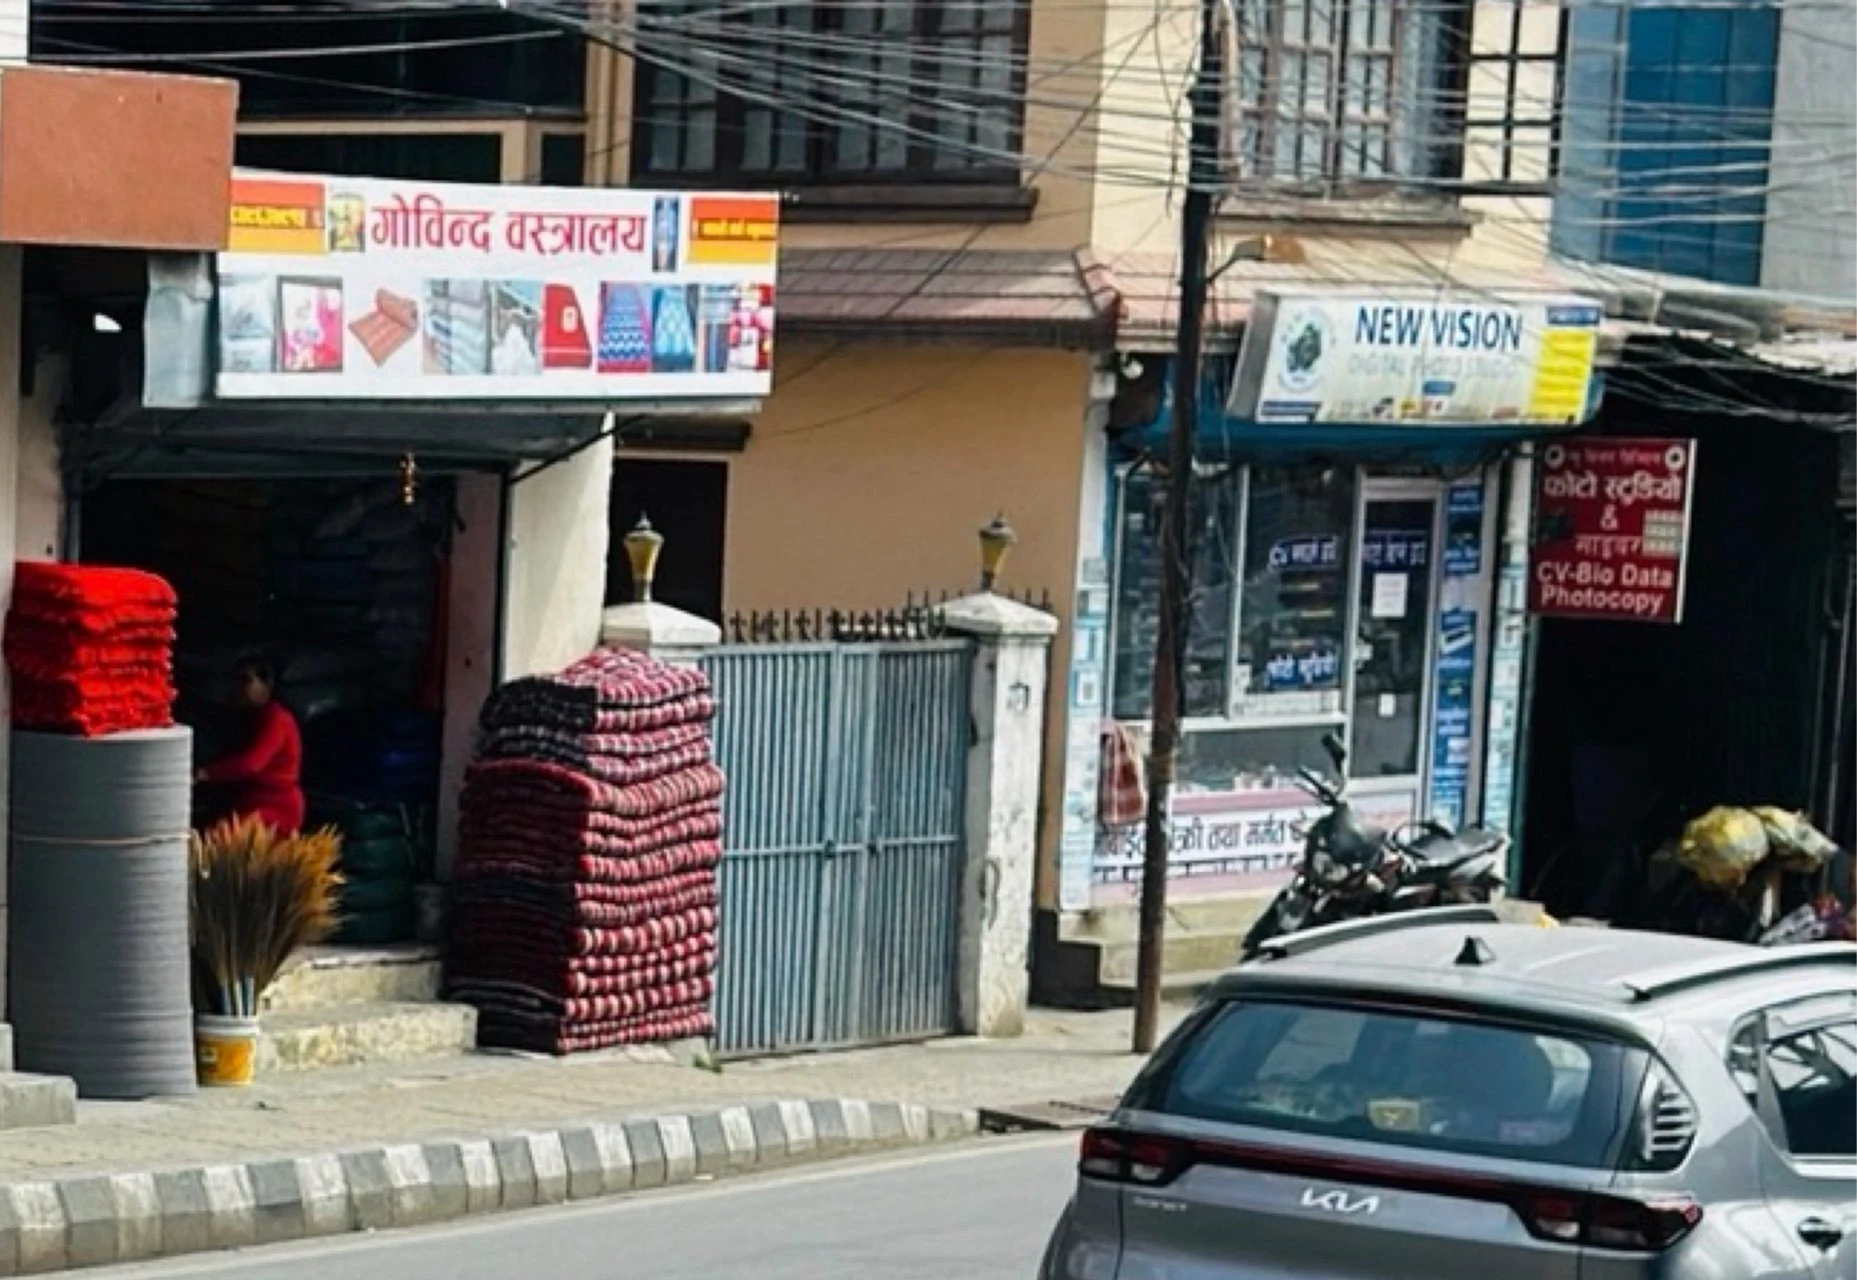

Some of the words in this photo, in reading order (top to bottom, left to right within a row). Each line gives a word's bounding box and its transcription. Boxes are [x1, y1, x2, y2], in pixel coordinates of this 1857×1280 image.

[371, 193, 495, 252] गोविन्द
[505, 211, 648, 255] वस्त्रालय
[1355, 305, 1424, 346] NEW
[1430, 308, 1523, 351] VISION
[1599, 503, 1619, 530] &
[1537, 561, 1615, 586] CV-Bio
[1621, 563, 1674, 588] Data
[1541, 584, 1664, 618] Photocopy
